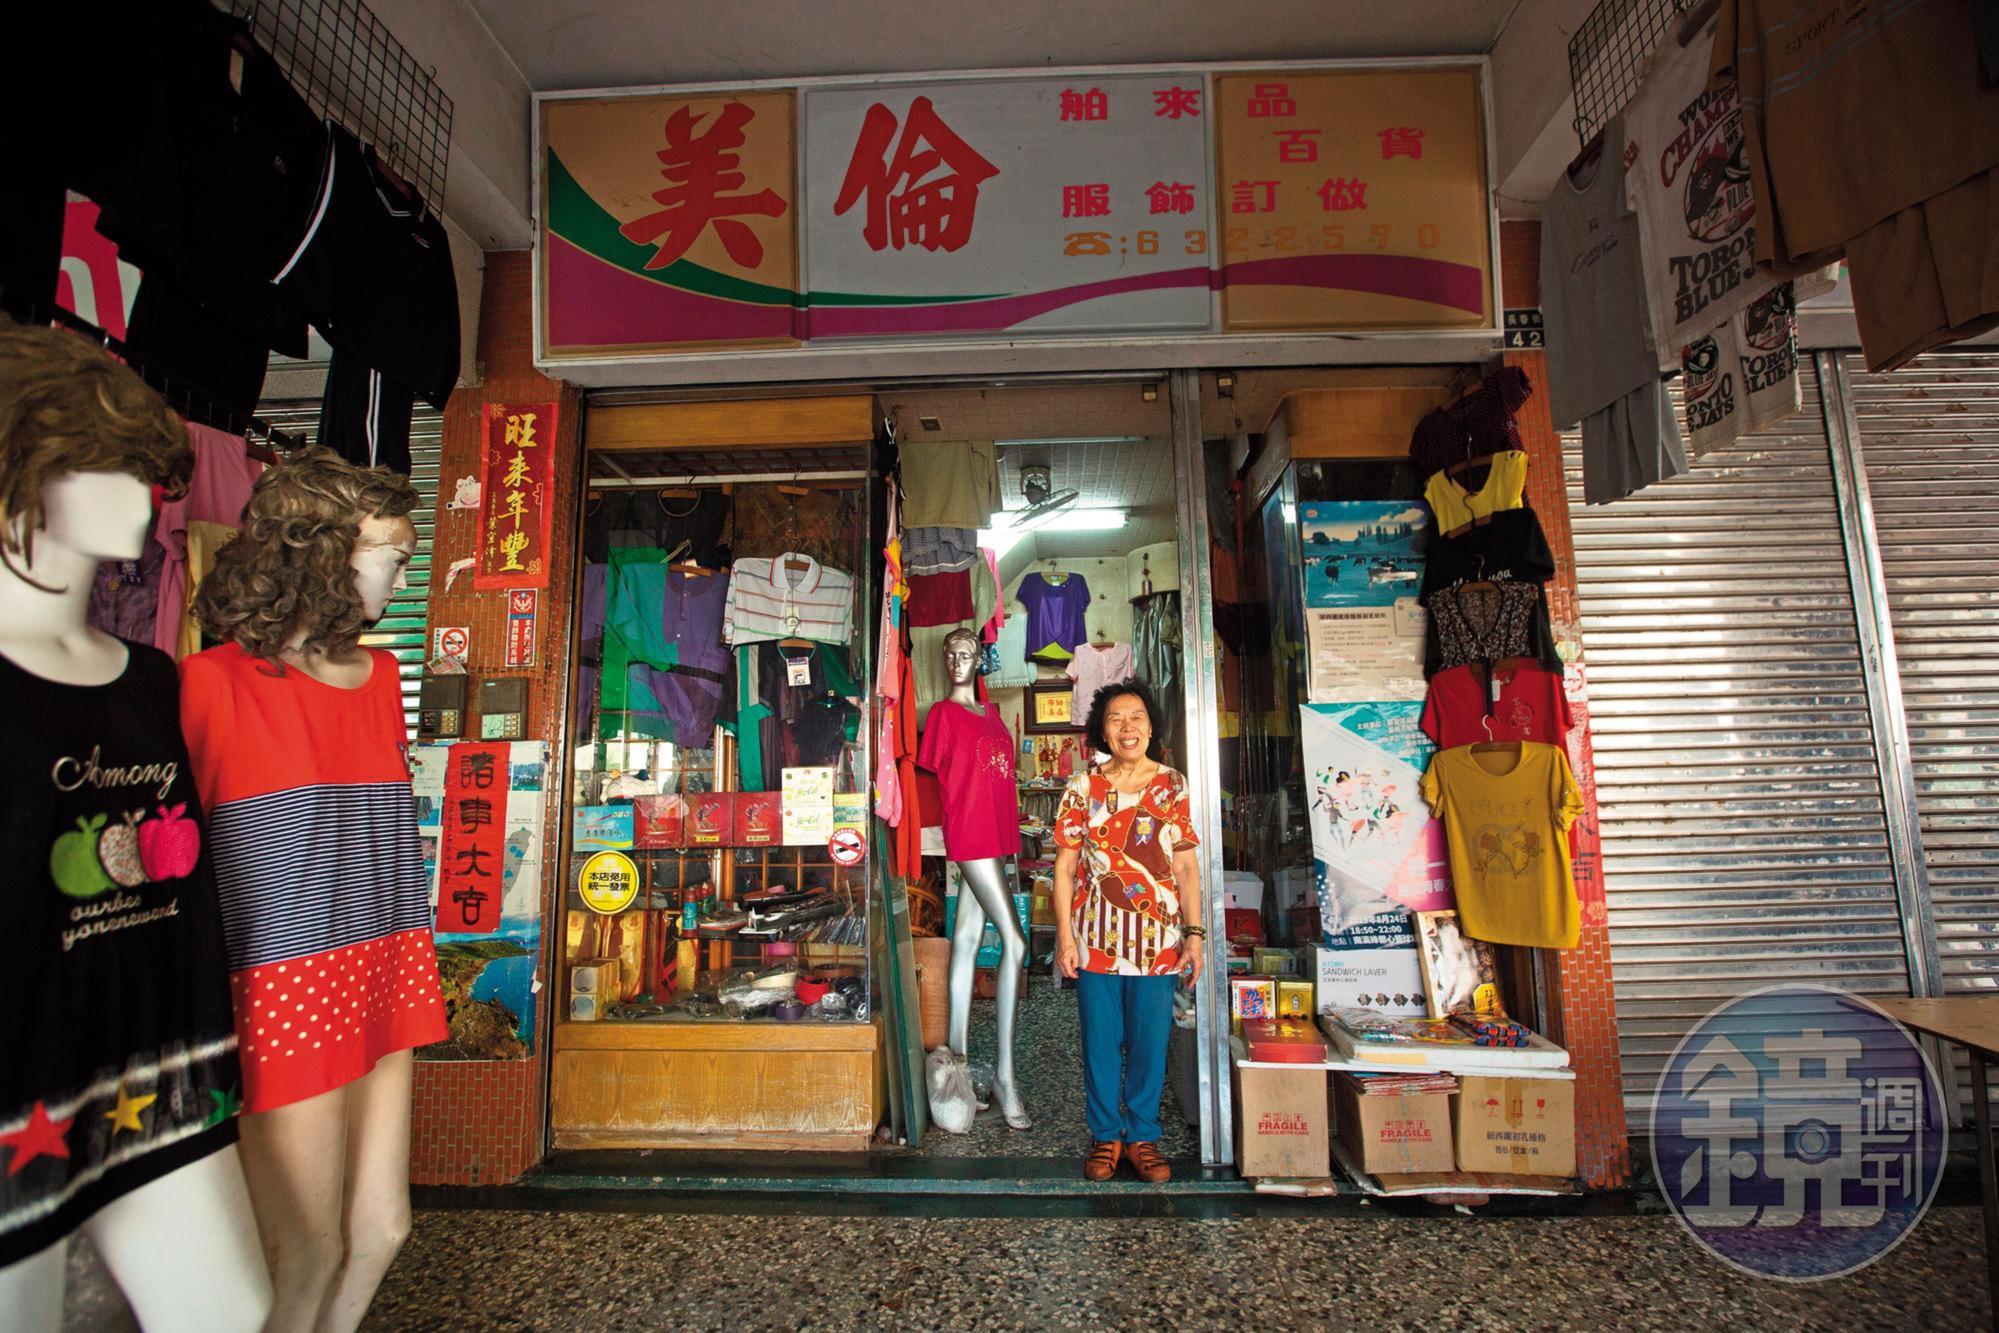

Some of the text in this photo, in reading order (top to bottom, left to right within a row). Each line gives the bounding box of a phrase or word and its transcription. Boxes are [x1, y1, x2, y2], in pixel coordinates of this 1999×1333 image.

[1059, 84, 1297, 121] 舶來品
[1274, 127, 1425, 163] 百貨
[619, 95, 1001, 271] 美倫
[1062, 177, 1367, 218] 服飾訂做
[1674, 259, 1741, 325] BLUE
[1512, 331, 1542, 347] 42
[51, 744, 178, 800] Among
[452, 751, 496, 926] 諸事大吉
[587, 882, 630, 892] 統一發票
[588, 872, 630, 882] 本店免用
[1351, 925, 1402, 935] 18:50~22:00
[1322, 968, 1387, 976] SANDWICH LAVER
[1258, 1122, 1308, 1130] FRAGILE
[1381, 1129, 1431, 1138] FRAGILE
